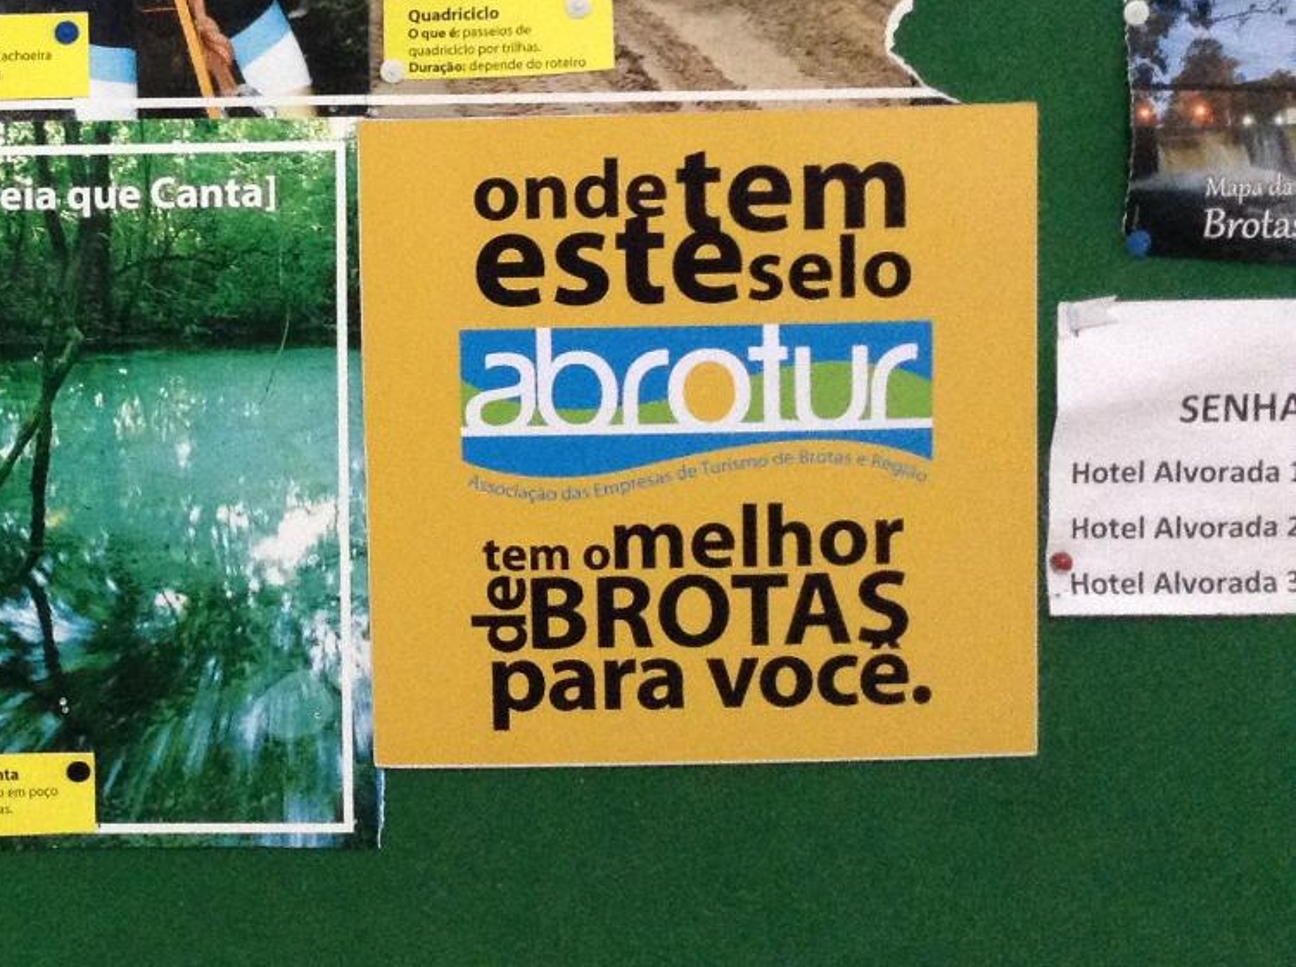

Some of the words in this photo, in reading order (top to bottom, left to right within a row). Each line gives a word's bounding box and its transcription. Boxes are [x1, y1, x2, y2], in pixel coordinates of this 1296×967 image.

[408, 6, 500, 23] Quadriciclo
[408, 28, 418, 39] O
[421, 28, 446, 40] que
[462, 26, 513, 40] passeios
[515, 25, 532, 35] de
[409, 62, 466, 75] Duração:
[469, 60, 523, 73] depende
[526, 59, 543, 69] do
[478, 45, 498, 57] por
[67, 183, 141, 218] que
[150, 175, 278, 212] Canta]
[473, 157, 667, 221] onde
[675, 150, 906, 233] tem
[1205, 176, 1263, 205] Mapa
[1269, 173, 1292, 196] da
[475, 215, 743, 308] este
[748, 234, 912, 301] selo
[460, 329, 924, 436] abrotur
[467, 475, 557, 505] Associação
[561, 484, 591, 502] das
[593, 472, 674, 497] Empresas
[677, 465, 697, 482] de
[701, 454, 769, 475] Turismo
[772, 452, 794, 466] de
[799, 449, 852, 465] Brotas
[871, 453, 928, 483] Região
[1072, 460, 1144, 484] Hotel
[1154, 460, 1280, 484] Alvorada
[483, 541, 570, 571] tem
[583, 544, 611, 570] o
[613, 503, 904, 569] melhor
[1072, 516, 1144, 539] Hotel
[1154, 515, 1278, 539] Alvorada
[1070, 572, 1144, 595] Hotel
[1154, 571, 1277, 594] Alvorada
[471, 575, 527, 653] de
[530, 570, 909, 650] BROTAS
[491, 657, 684, 731] para
[7, 789, 25, 798] em
[29, 787, 59, 799] poço
